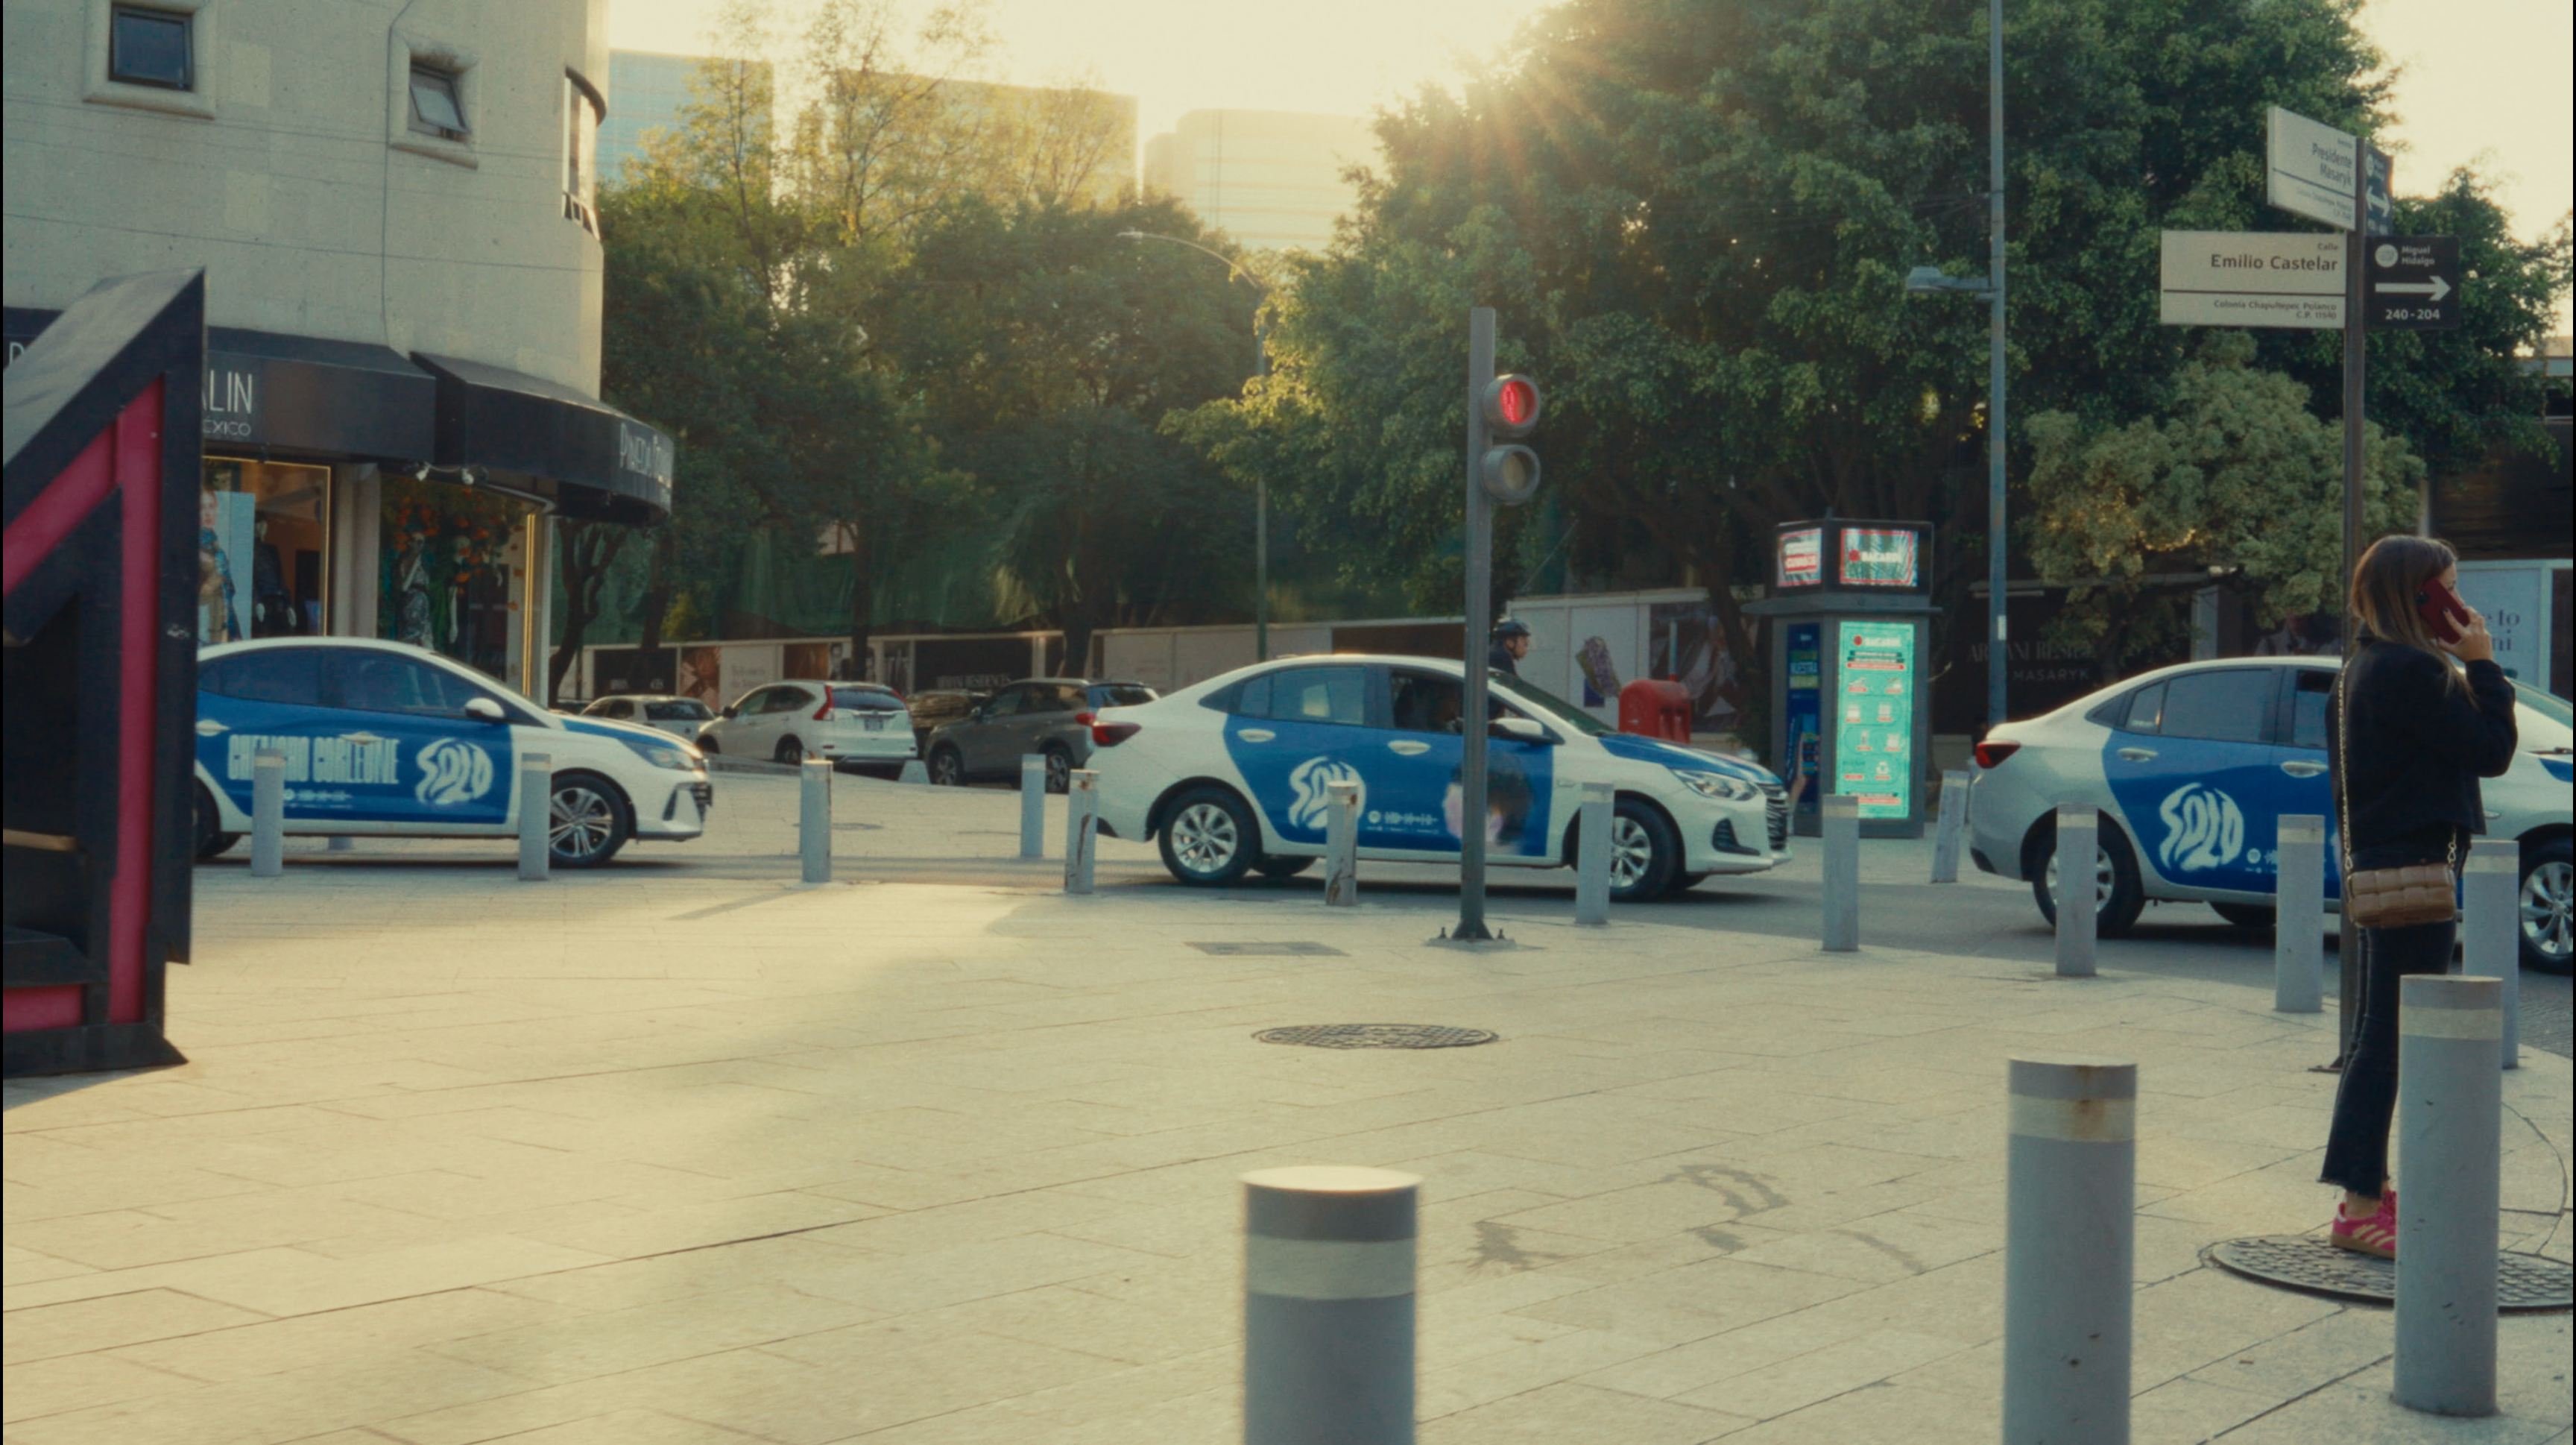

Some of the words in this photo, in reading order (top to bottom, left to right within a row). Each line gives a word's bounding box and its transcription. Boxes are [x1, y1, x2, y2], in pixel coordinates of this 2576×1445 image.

[2312, 142, 2352, 169] Presidente
[2320, 163, 2352, 186] Masaryk
[2317, 242, 2338, 251] Calle
[2402, 246, 2431, 256] Miguel
[2211, 254, 2264, 269] Emilio
[2270, 256, 2338, 271] Castelar
[2402, 256, 2435, 266] Hidalgo
[2214, 300, 2246, 309] Colonia
[2249, 301, 2299, 311] Chapultepec
[2303, 302, 2337, 311] Polanco
[201, 369, 253, 414] LIN
[202, 416, 252, 436] ÉXICO
[2013, 669, 2090, 681] MASARYK
[416, 737, 493, 805] SOLO
[2159, 781, 2244, 872] SOLO
